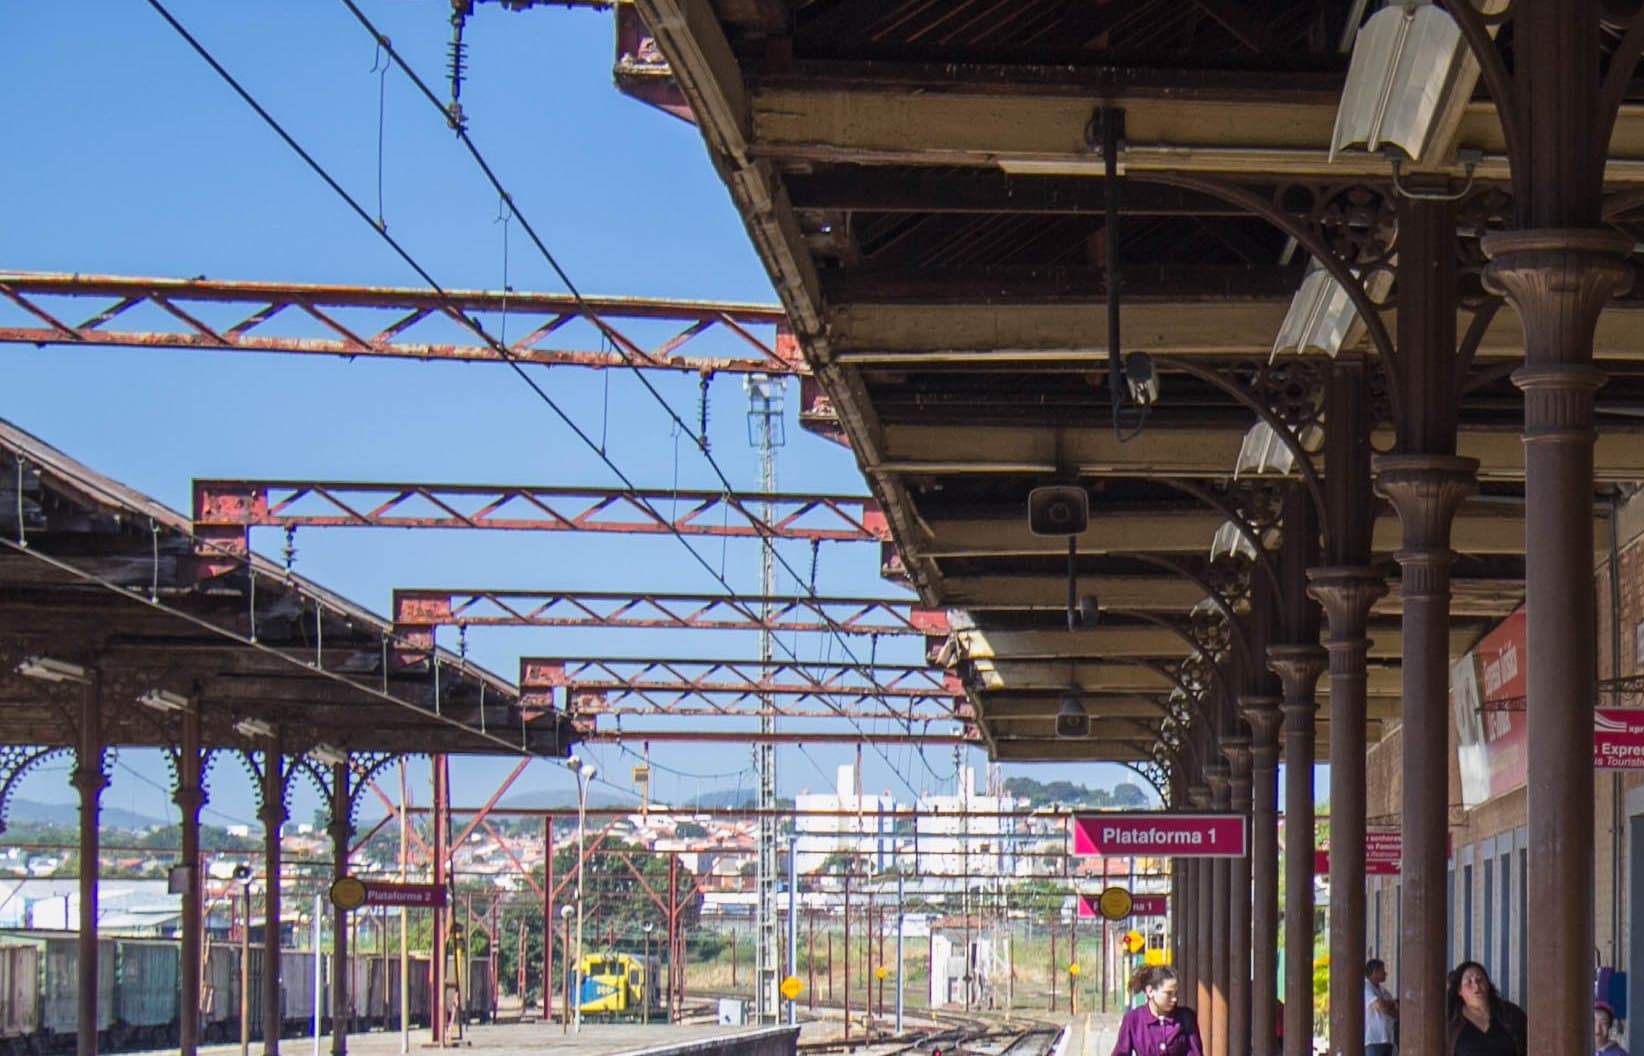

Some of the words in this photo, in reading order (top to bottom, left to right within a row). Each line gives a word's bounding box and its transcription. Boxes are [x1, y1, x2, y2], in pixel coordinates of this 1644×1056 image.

[1103, 828, 1203, 845] Plataforma
[1207, 828, 1217, 844] 1
[367, 889, 423, 901] Plataforma
[425, 891, 432, 902] 2
